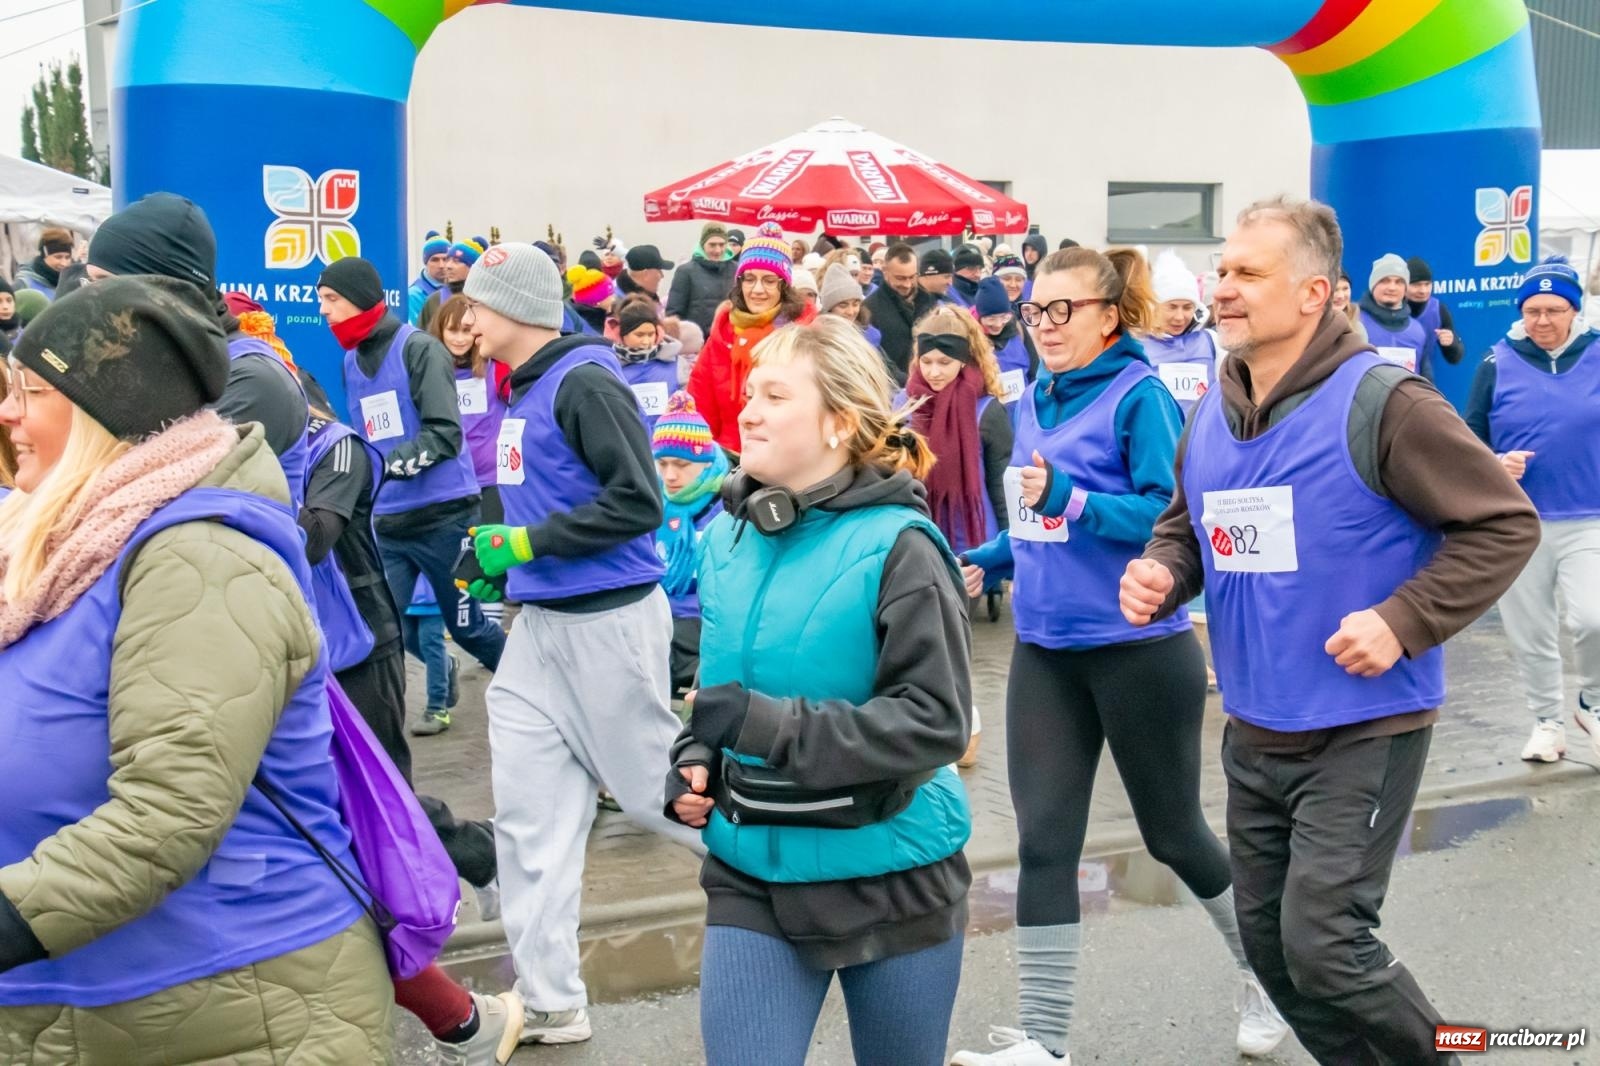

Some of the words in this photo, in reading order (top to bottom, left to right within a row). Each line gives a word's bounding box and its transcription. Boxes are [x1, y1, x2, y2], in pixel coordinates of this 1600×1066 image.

[749, 152, 809, 195] WARKA
[849, 153, 898, 199] WARKA
[756, 205, 800, 221] Classic
[831, 213, 876, 225] WARKA
[906, 210, 950, 229] Classic
[286, 315, 322, 326] poznaj
[1175, 377, 1200, 391] 107
[641, 396, 660, 409] 32
[370, 411, 391, 433] 118
[1229, 524, 1260, 555] 82
